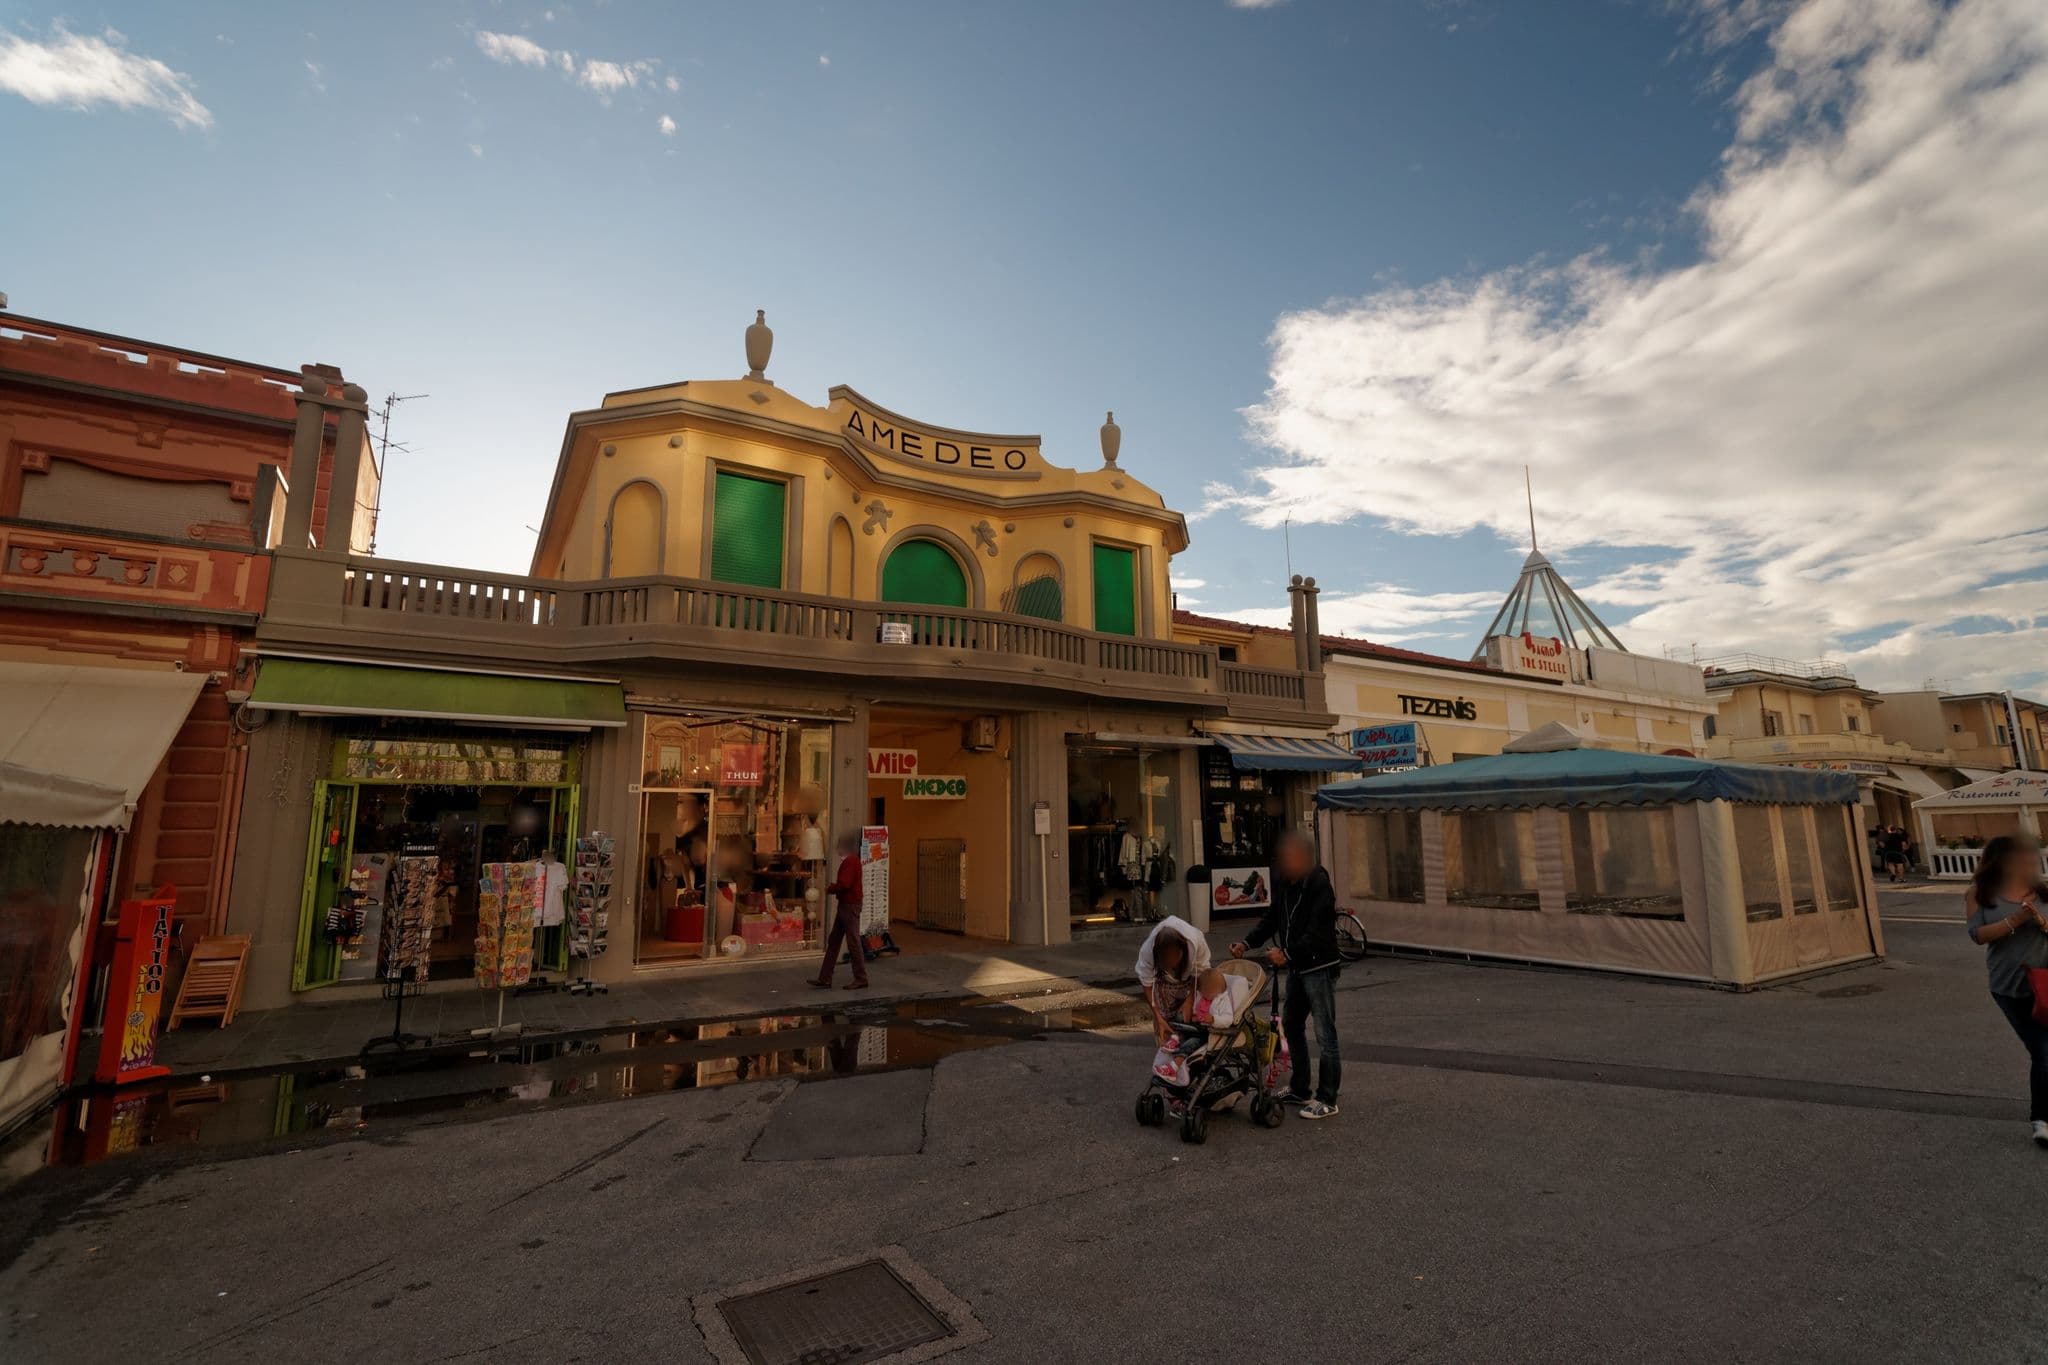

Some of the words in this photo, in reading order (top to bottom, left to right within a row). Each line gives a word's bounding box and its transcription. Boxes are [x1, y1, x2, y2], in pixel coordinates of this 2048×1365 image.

[847, 410, 1027, 471] AMEDEO
[726, 771, 758, 780] THUN
[1948, 791, 2021, 800] Ristorante
[146, 905, 174, 994] TATTOO
